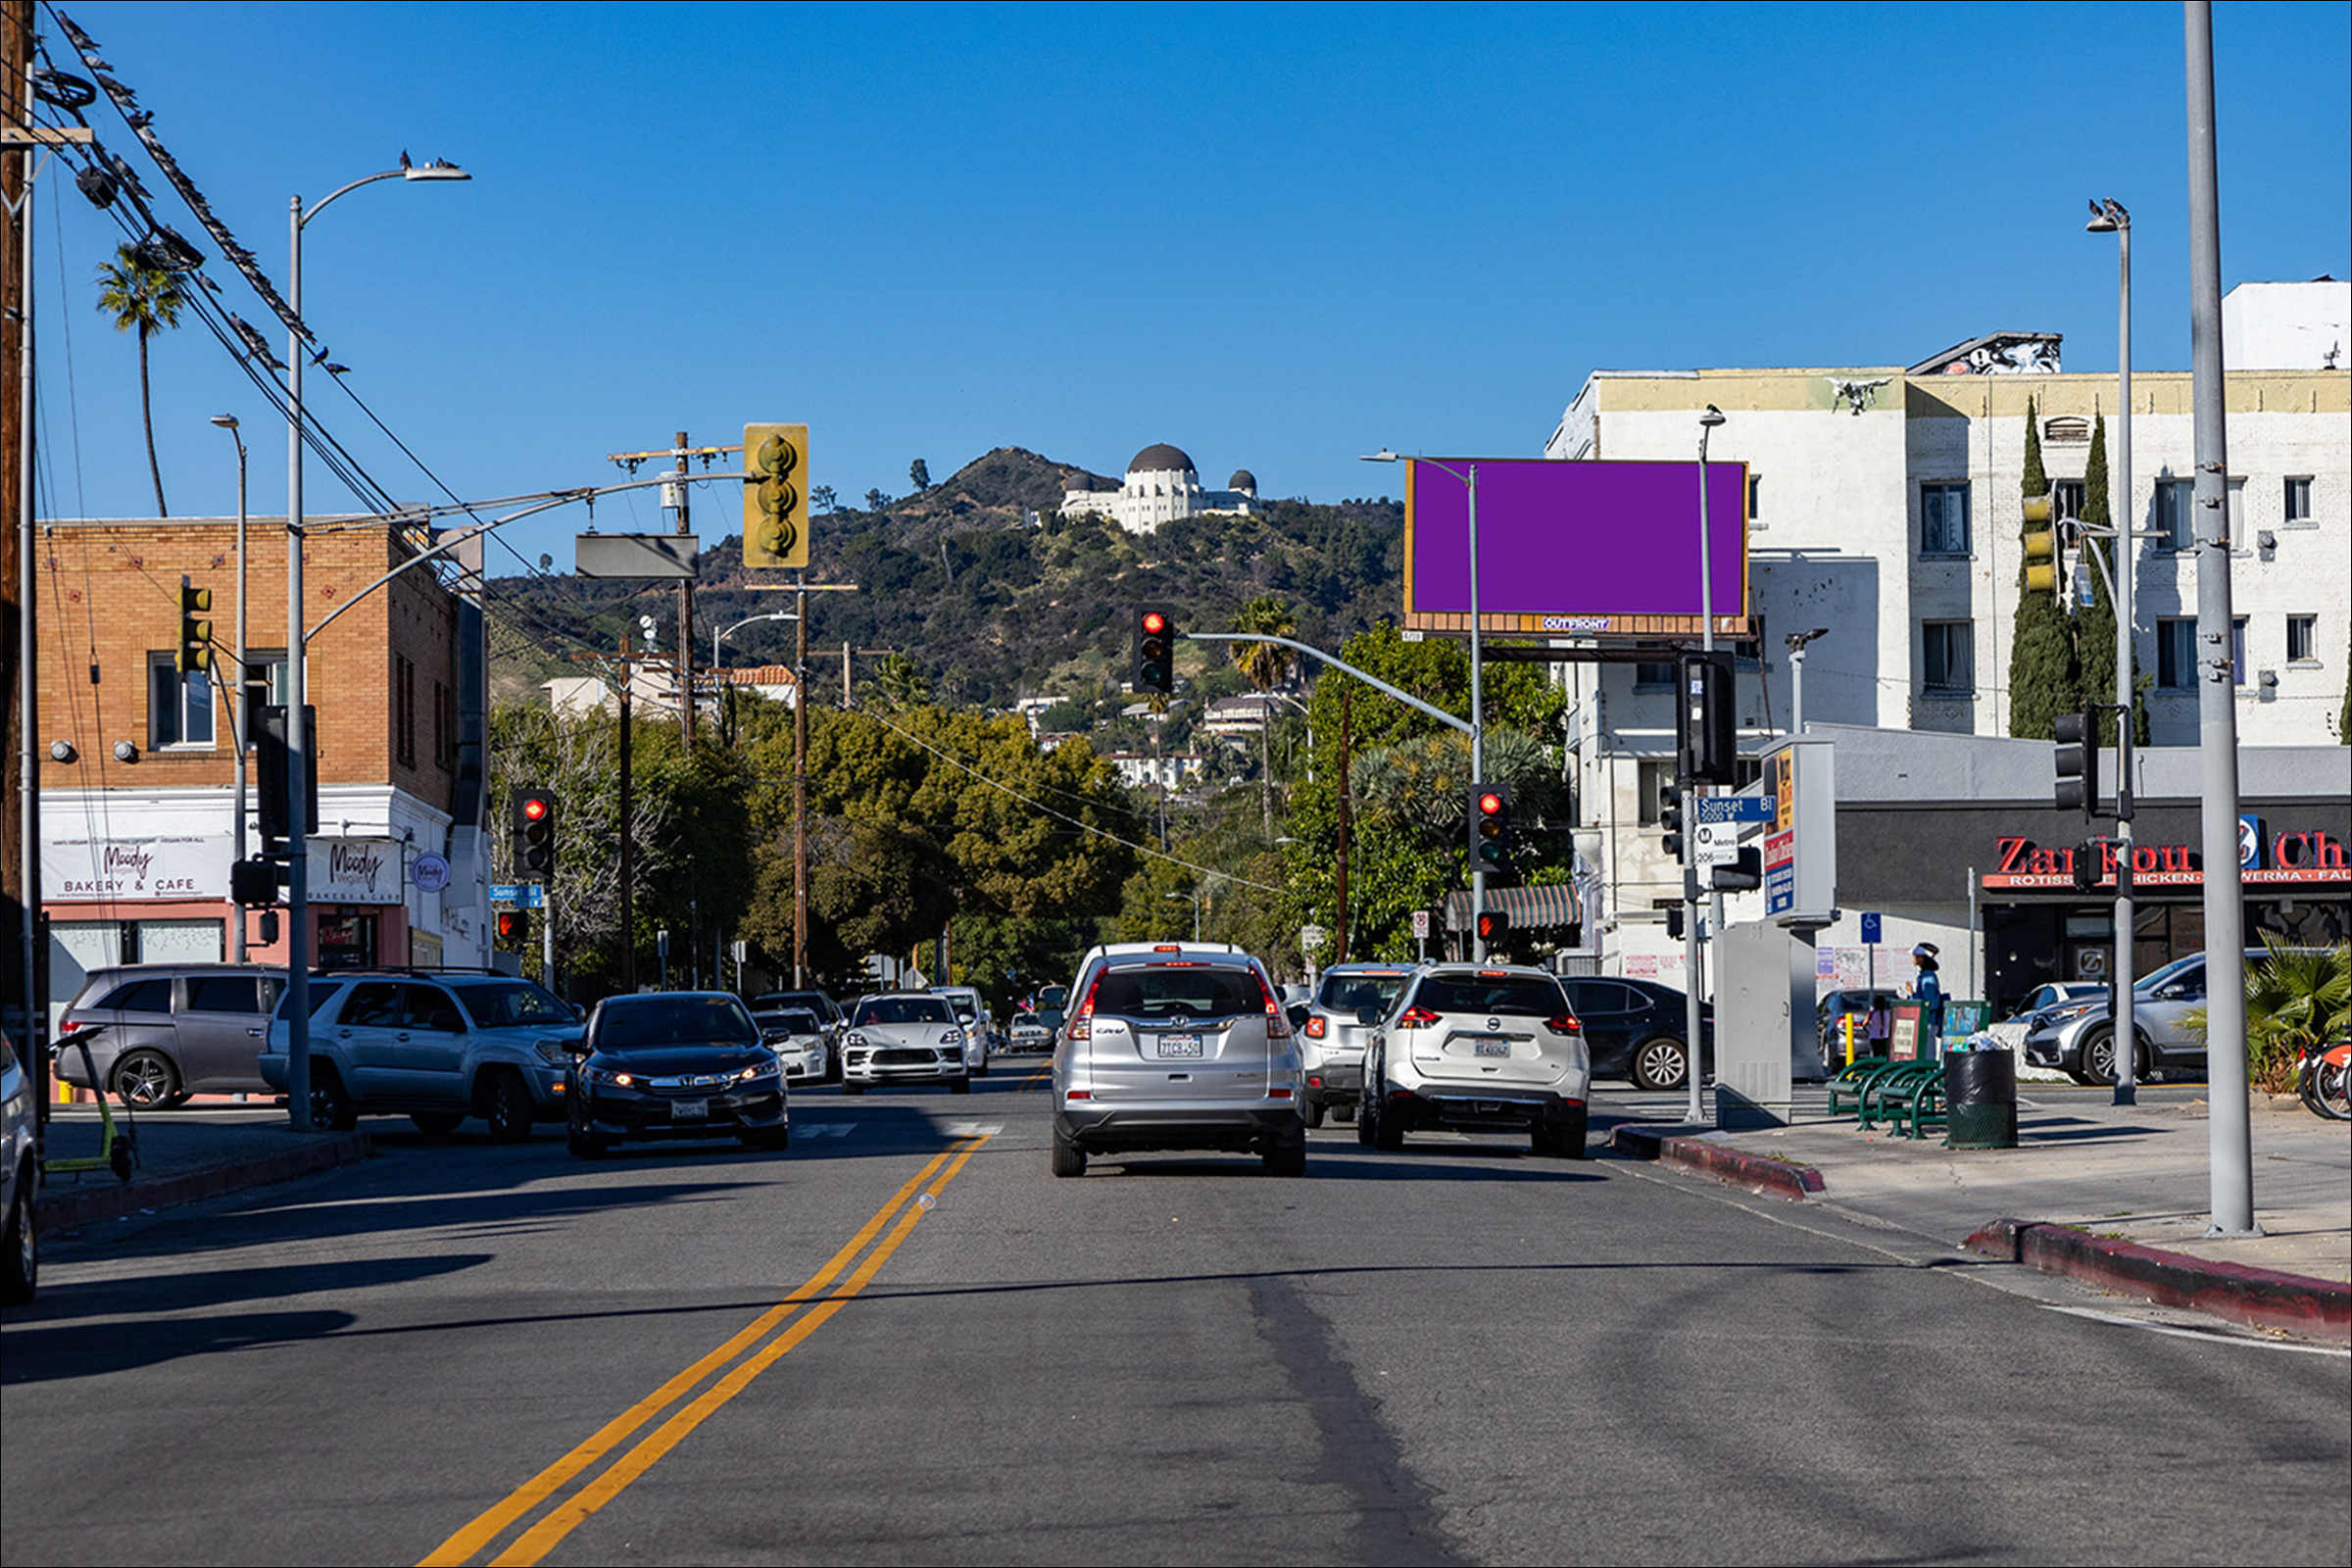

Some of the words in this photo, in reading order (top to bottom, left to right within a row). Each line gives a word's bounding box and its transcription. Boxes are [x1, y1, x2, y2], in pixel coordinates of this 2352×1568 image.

[1544, 618, 1608, 629] OUTFRONT
[1701, 799, 1743, 812] Sunset
[1760, 798, 1772, 811] Bl
[1701, 811, 1724, 822] 5000
[2272, 830, 2351, 870] Ch
[104, 846, 154, 880] Moody
[1698, 853, 1714, 863] 206
[330, 844, 385, 893] Moody
[65, 880, 123, 892] BAKERY
[134, 880, 144, 891] &
[155, 879, 194, 890] CAFE
[2010, 875, 2113, 886] ROTISSE
[2132, 874, 2194, 883] HICKEN
